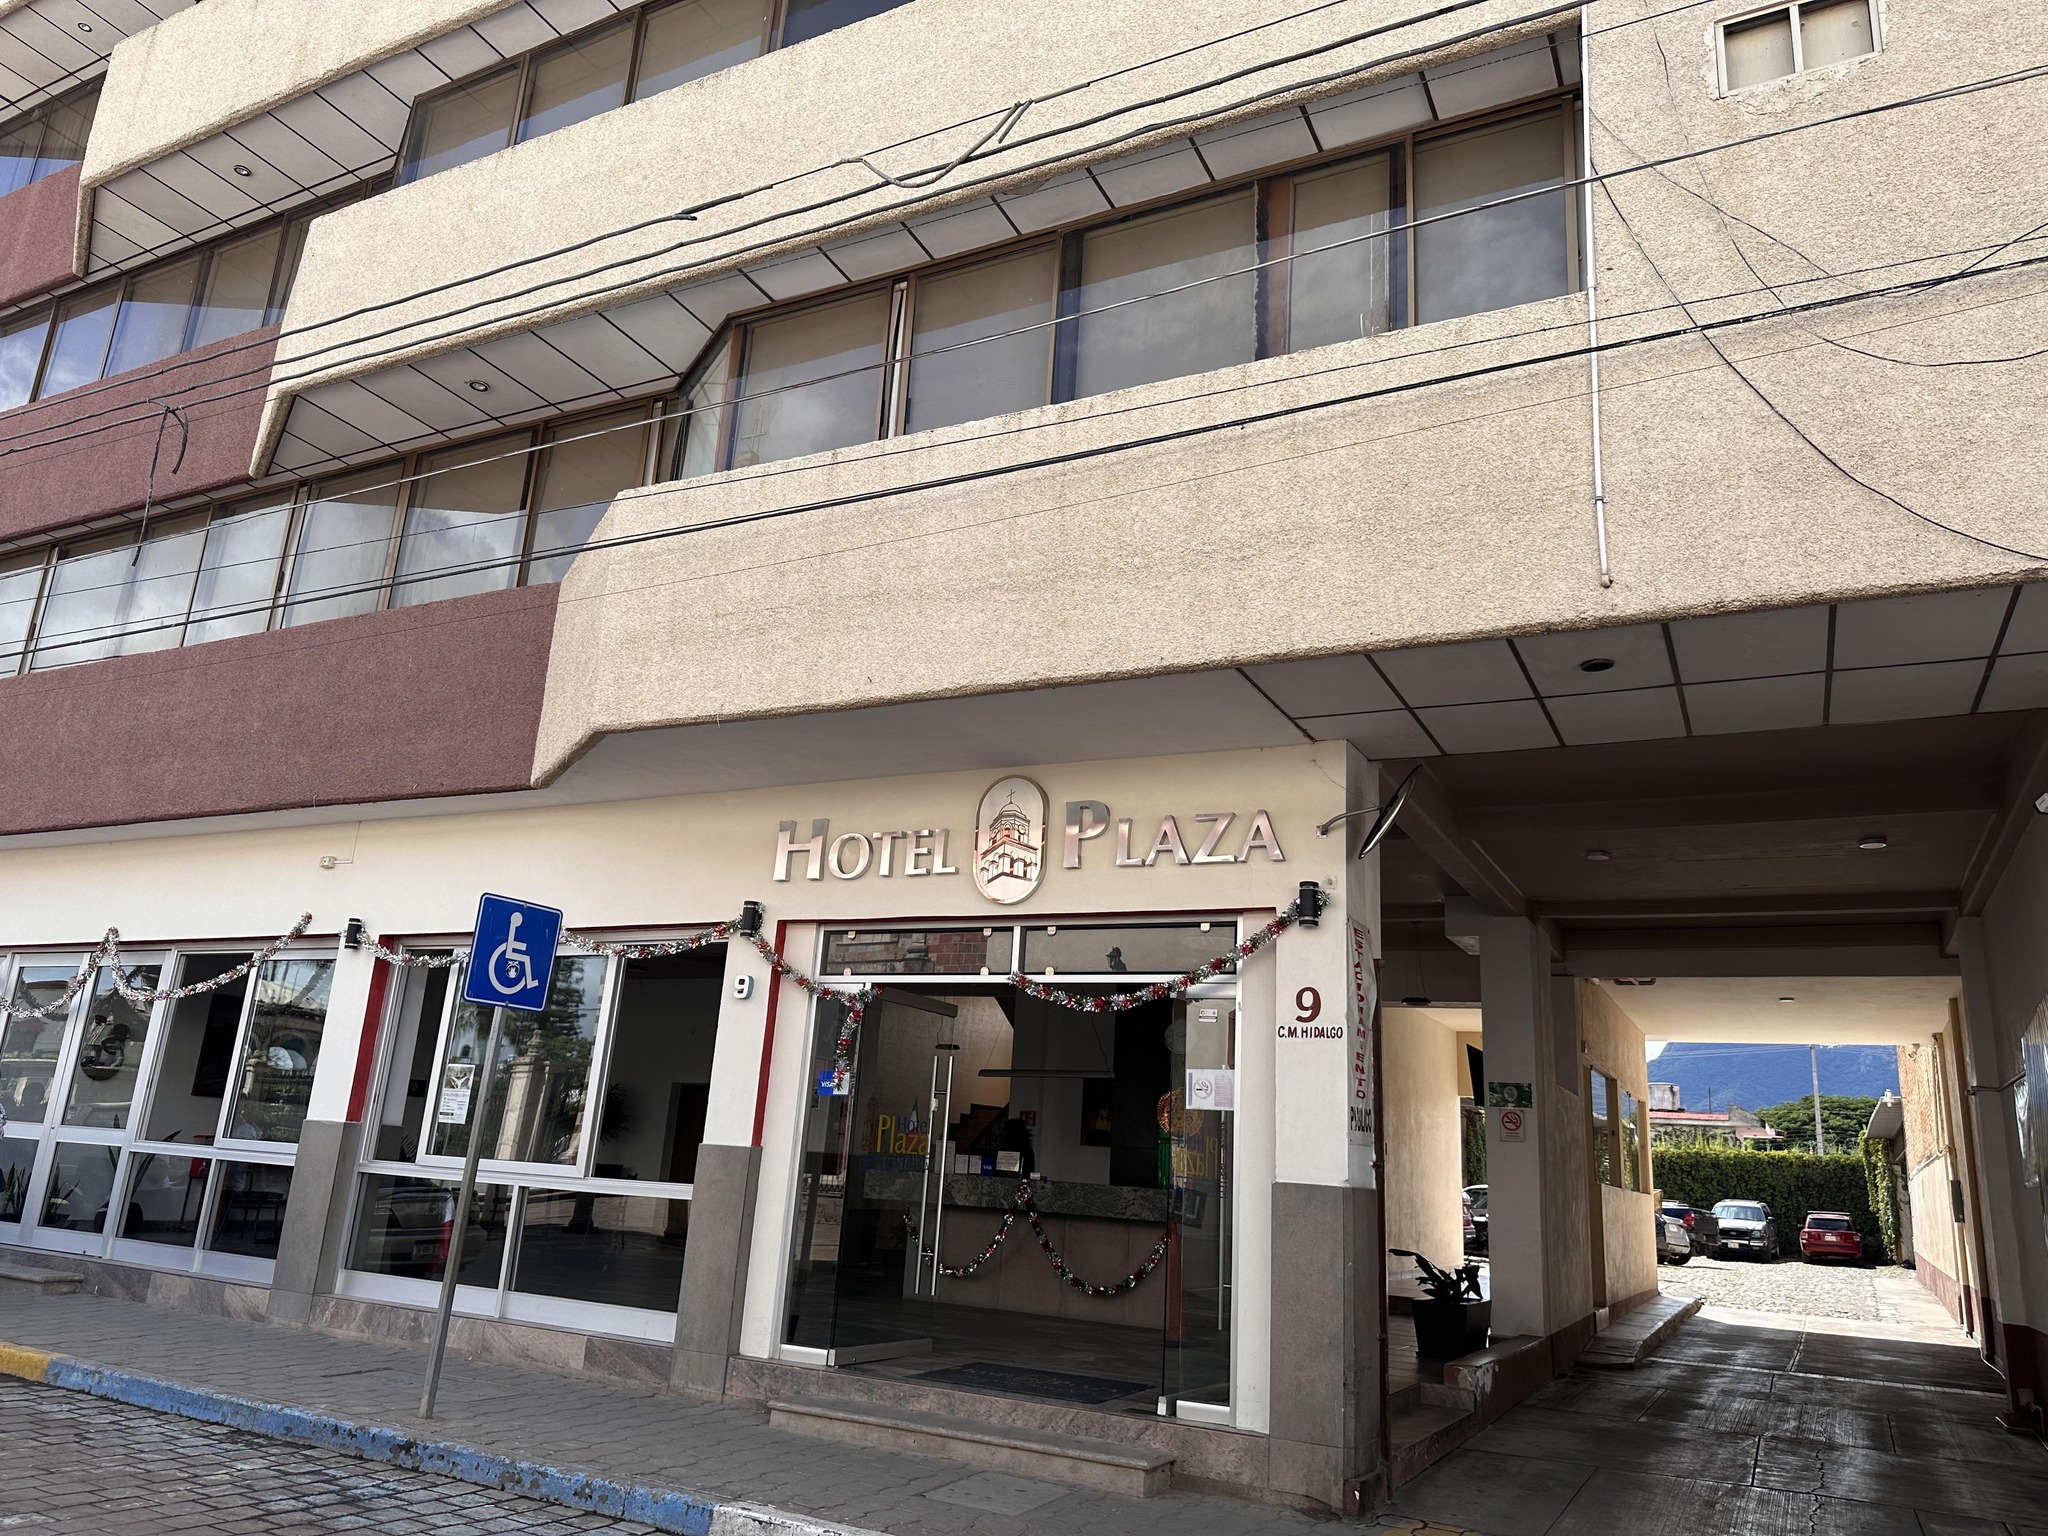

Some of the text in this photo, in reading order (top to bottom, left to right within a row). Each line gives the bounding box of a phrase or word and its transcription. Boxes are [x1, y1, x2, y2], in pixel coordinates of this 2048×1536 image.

[773, 800, 1286, 882] HOTEL PLAZA
[733, 974, 754, 999] 9
[1295, 986, 1321, 1023] 9
[1301, 1026, 1343, 1039] HIDALGO
[876, 1114, 928, 1155] Plaza
